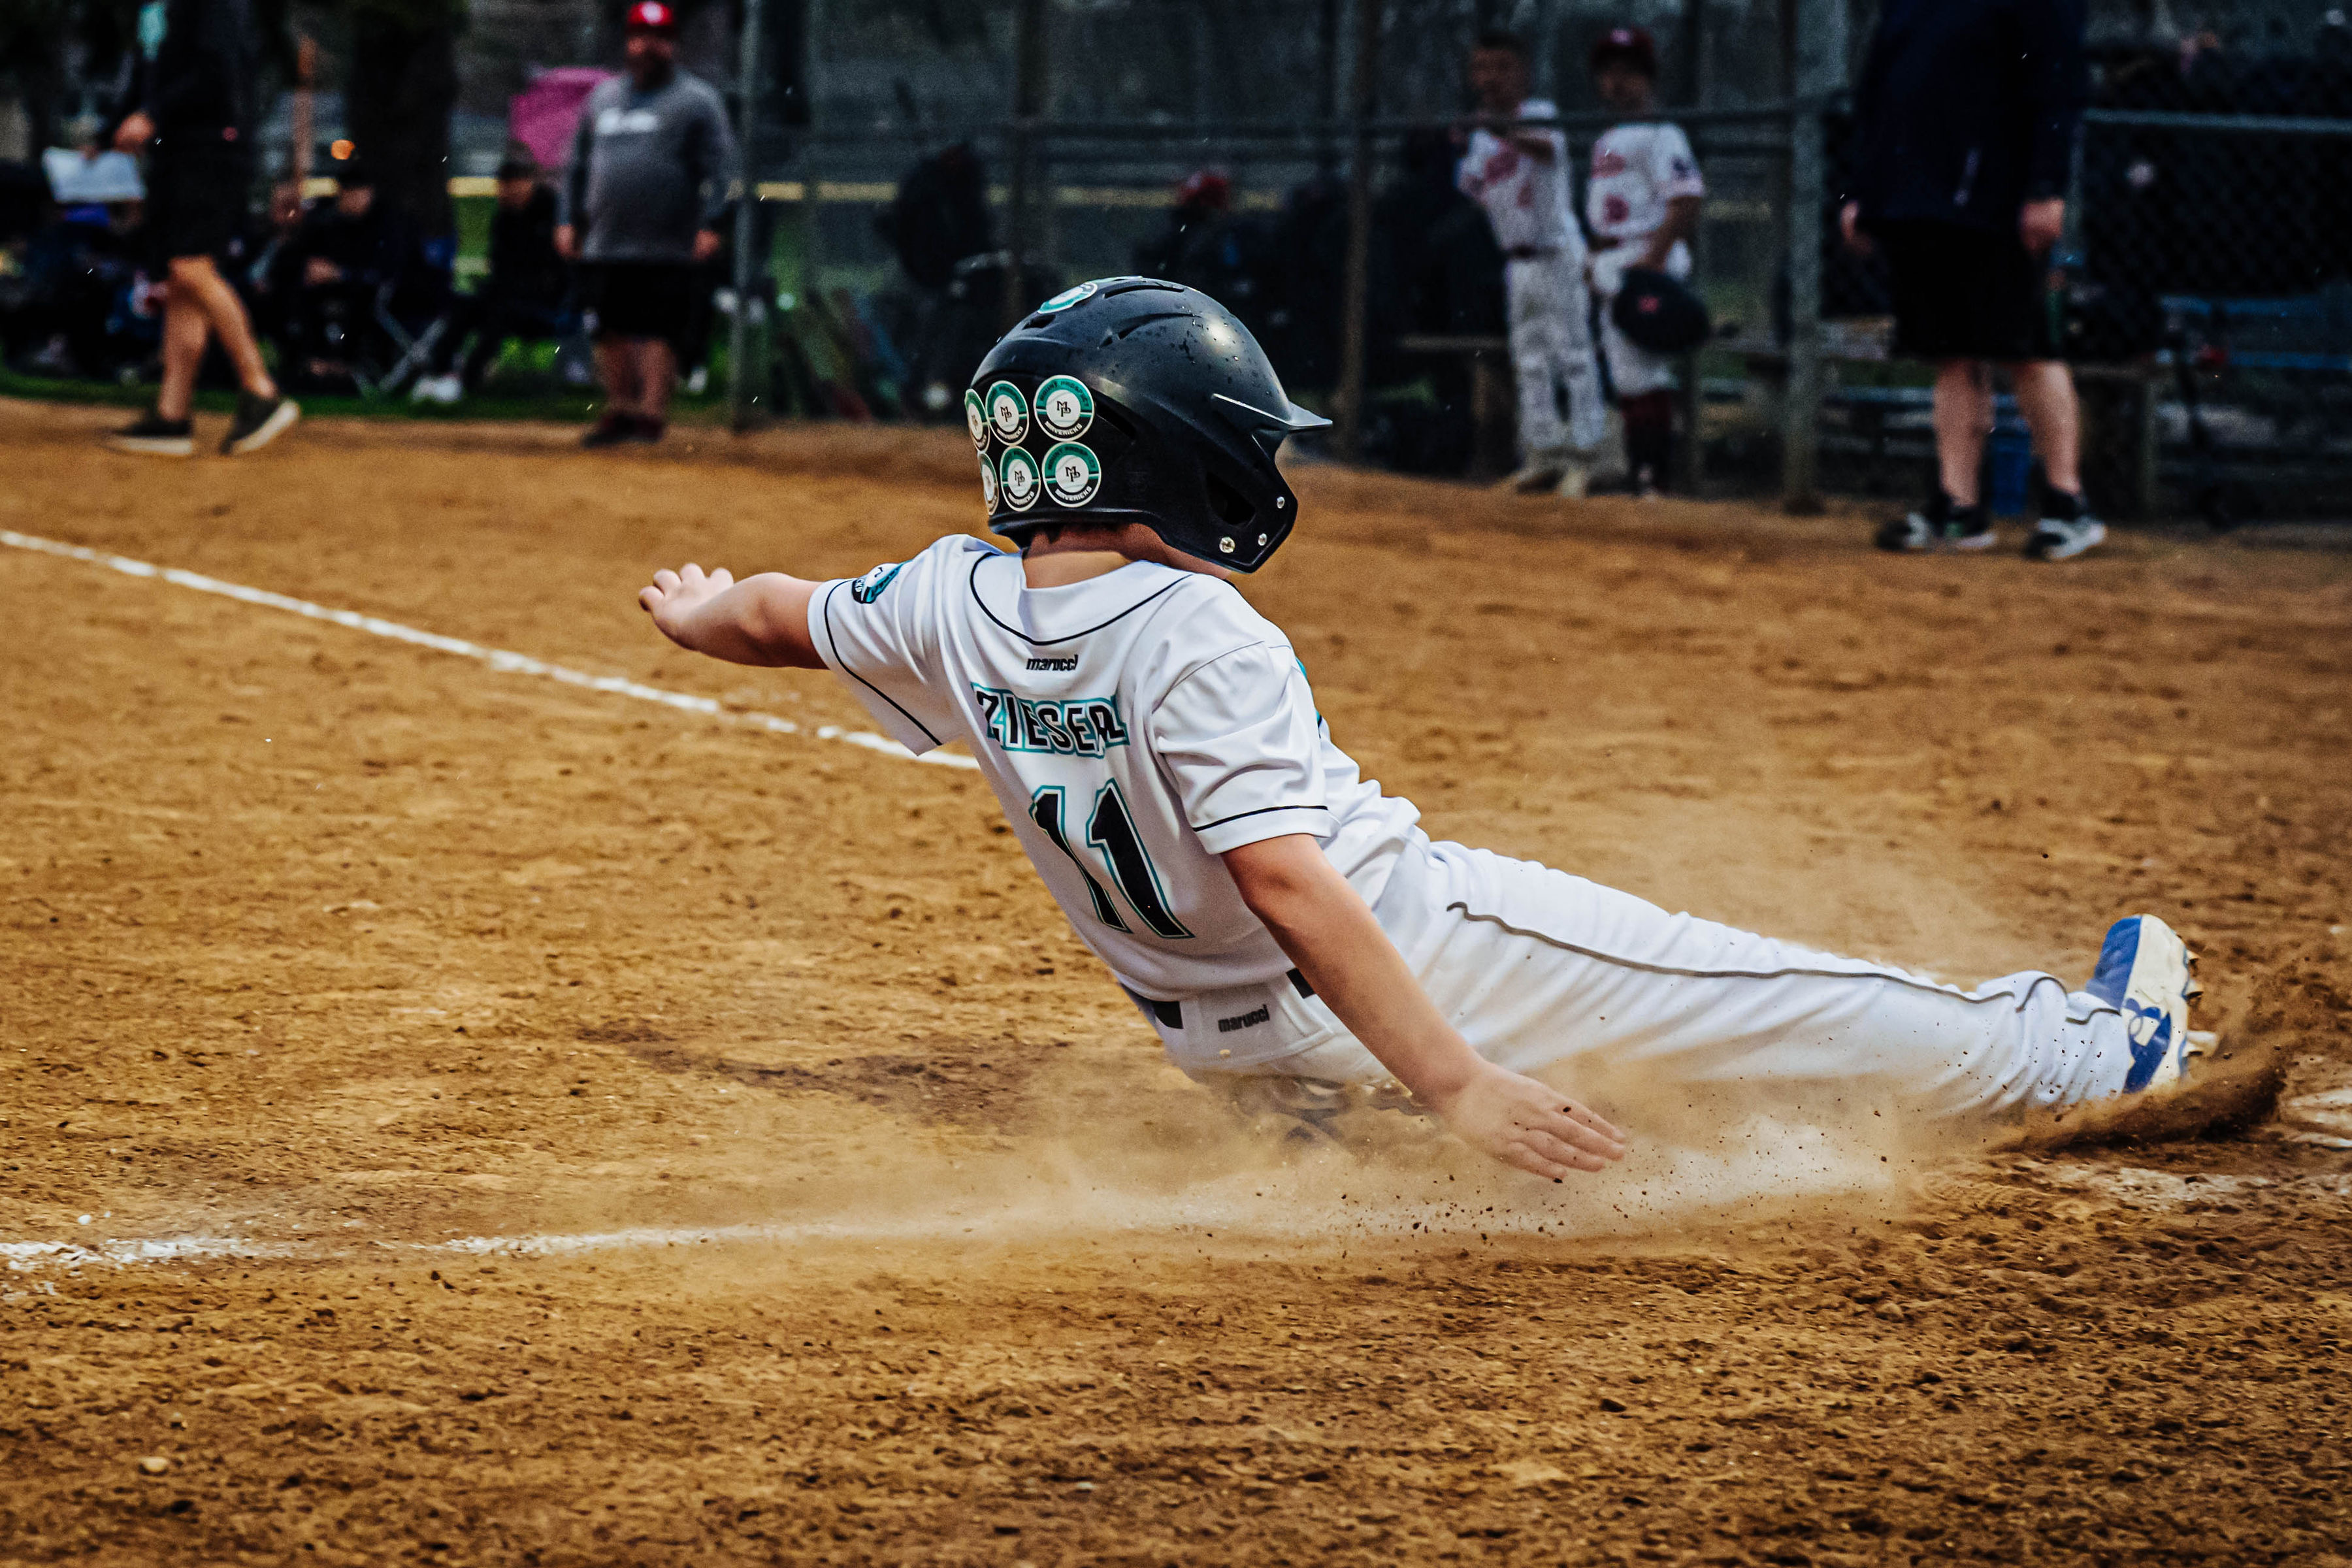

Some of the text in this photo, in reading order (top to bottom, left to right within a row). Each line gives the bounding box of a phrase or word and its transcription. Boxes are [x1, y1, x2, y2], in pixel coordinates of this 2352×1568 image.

[1065, 446, 1096, 468] PROSPCT
[972, 683, 1130, 759] ZIESER
[1028, 777, 1196, 939] 11
[1217, 1004, 1270, 1032] marucci
